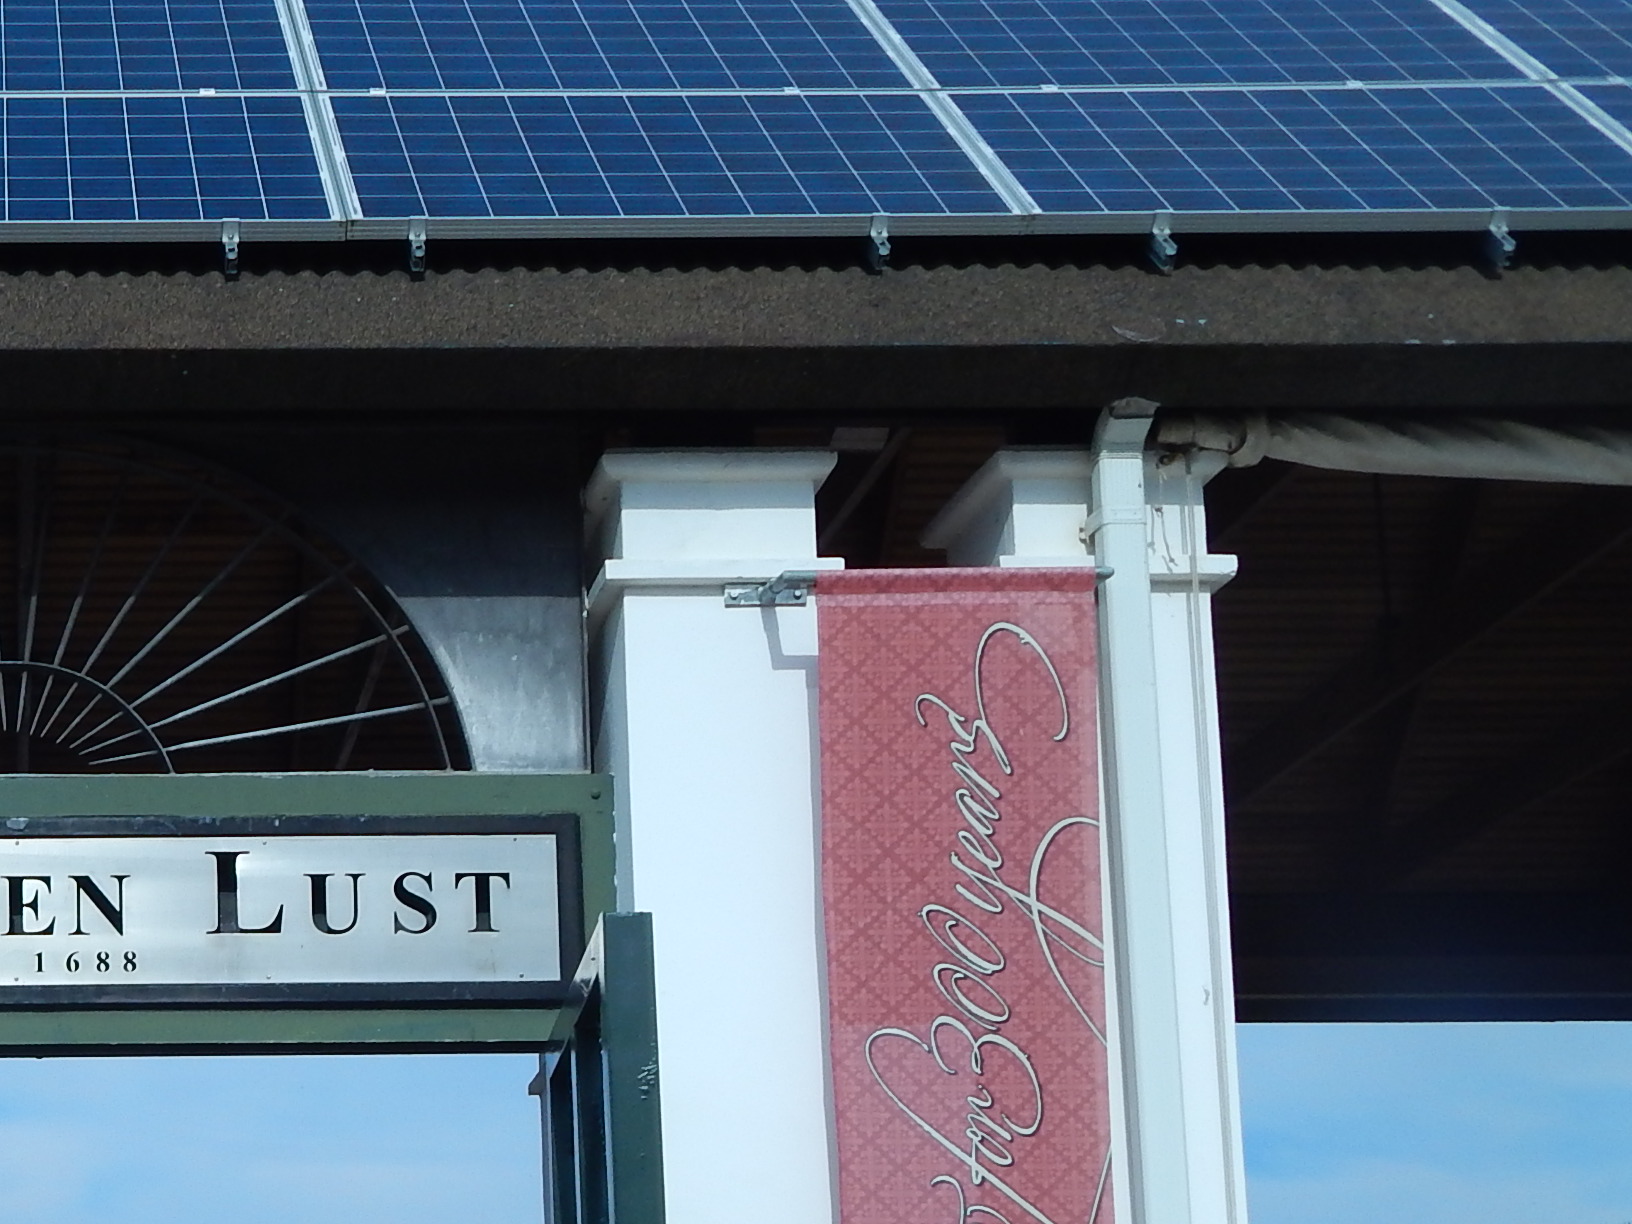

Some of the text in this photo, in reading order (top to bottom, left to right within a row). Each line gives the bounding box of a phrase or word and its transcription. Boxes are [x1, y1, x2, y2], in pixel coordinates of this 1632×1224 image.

[914, 620, 1104, 967] years
[0, 873, 131, 939] EN
[205, 850, 511, 936] LUST
[35, 951, 141, 976] 1688
[917, 902, 1043, 1136] 300
